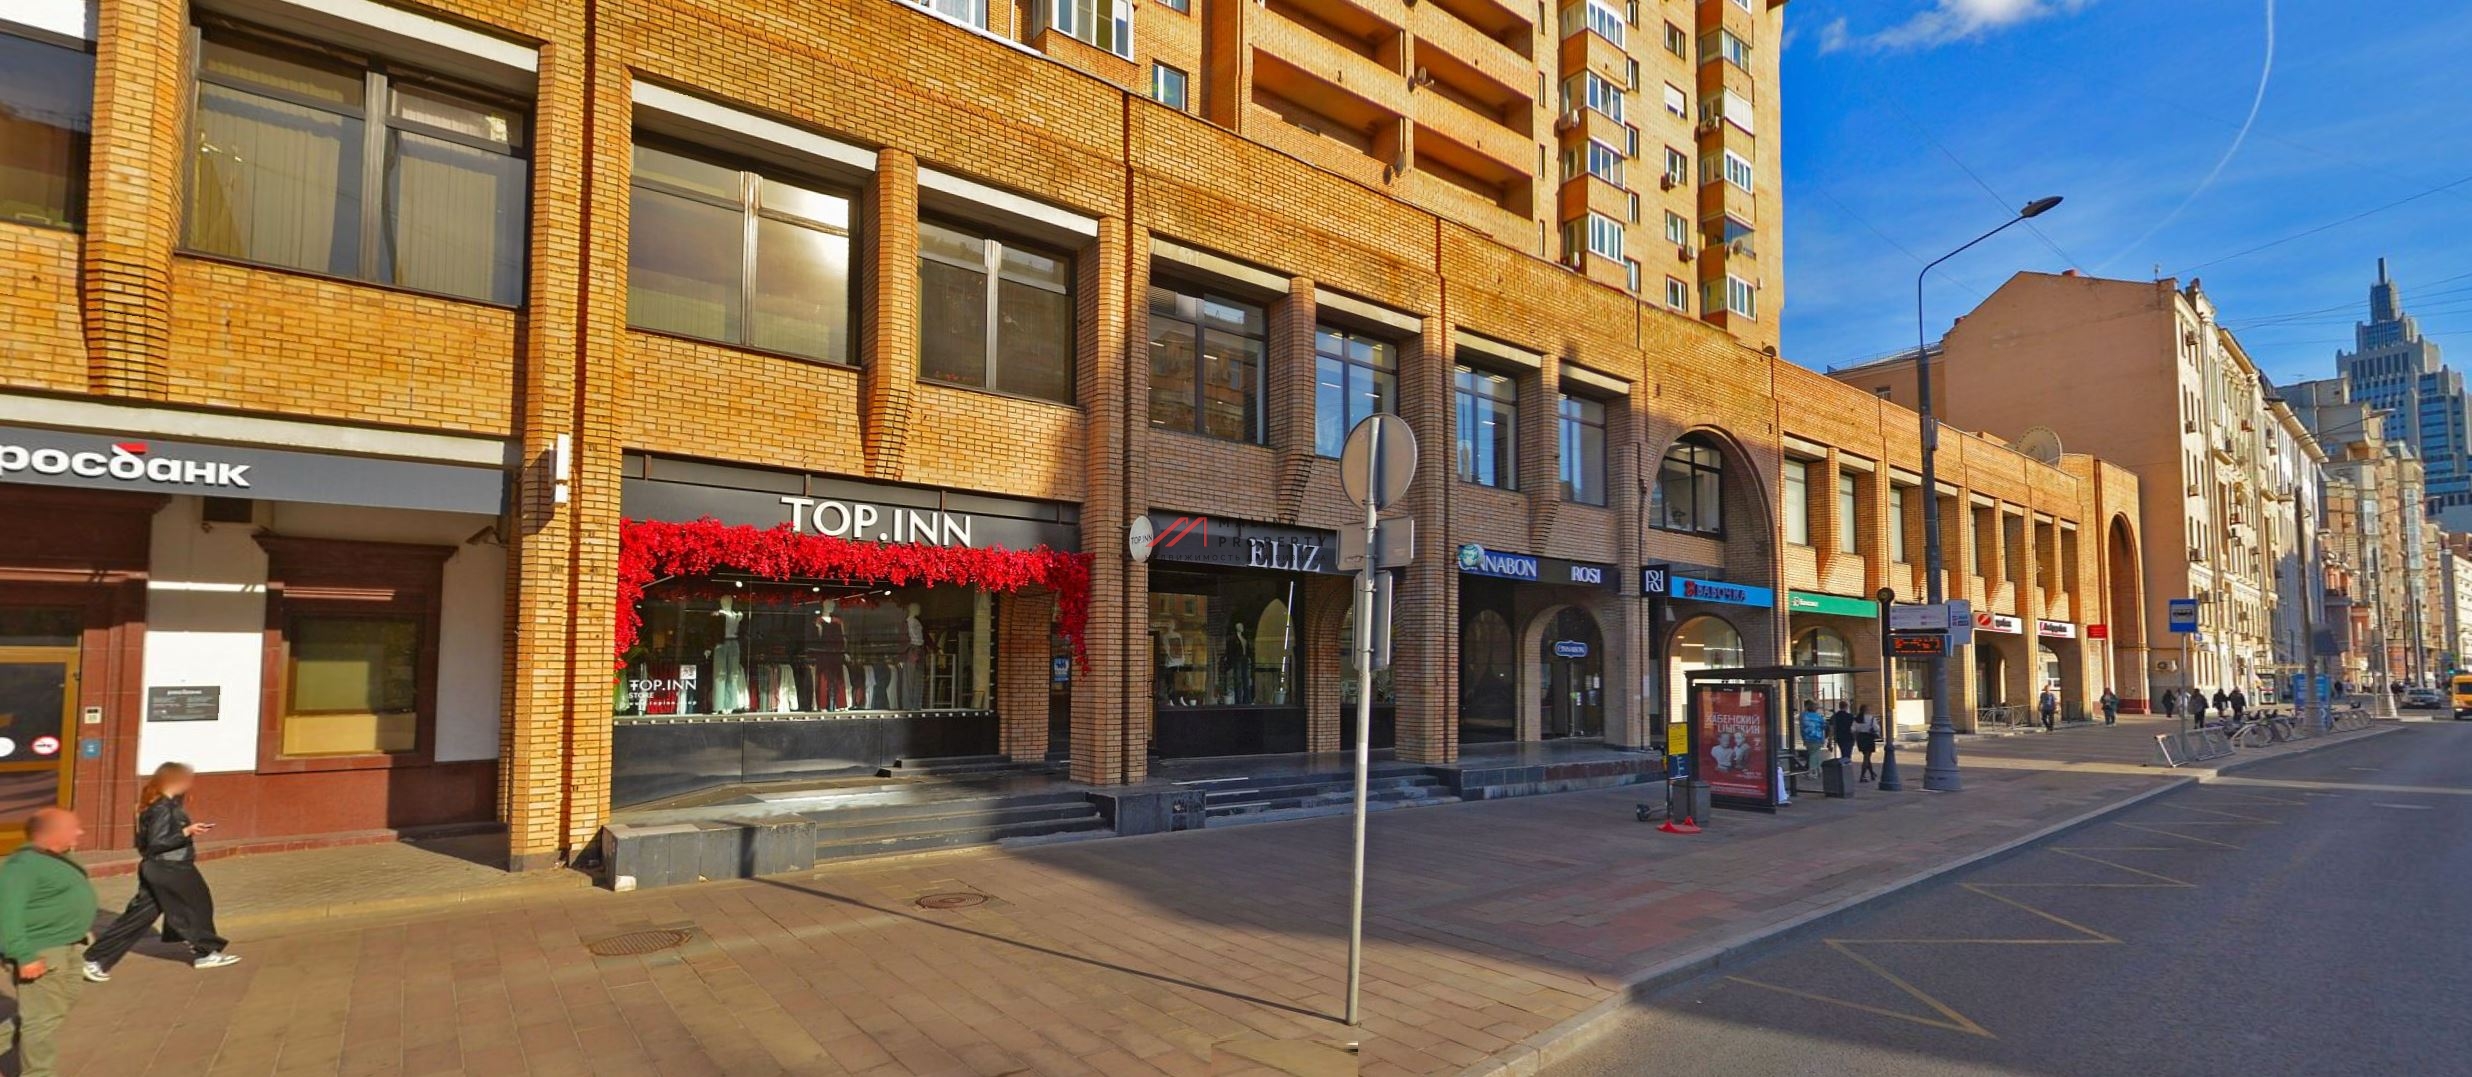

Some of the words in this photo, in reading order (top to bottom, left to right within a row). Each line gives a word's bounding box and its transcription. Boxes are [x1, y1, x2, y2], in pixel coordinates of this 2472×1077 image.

[0, 443, 251, 487] росбанк
[781, 496, 971, 548] TOP.INN
[1247, 538, 1321, 573] ELIZ
[1571, 566, 1601, 584] ROSI
[629, 679, 697, 691] TOP.INN
